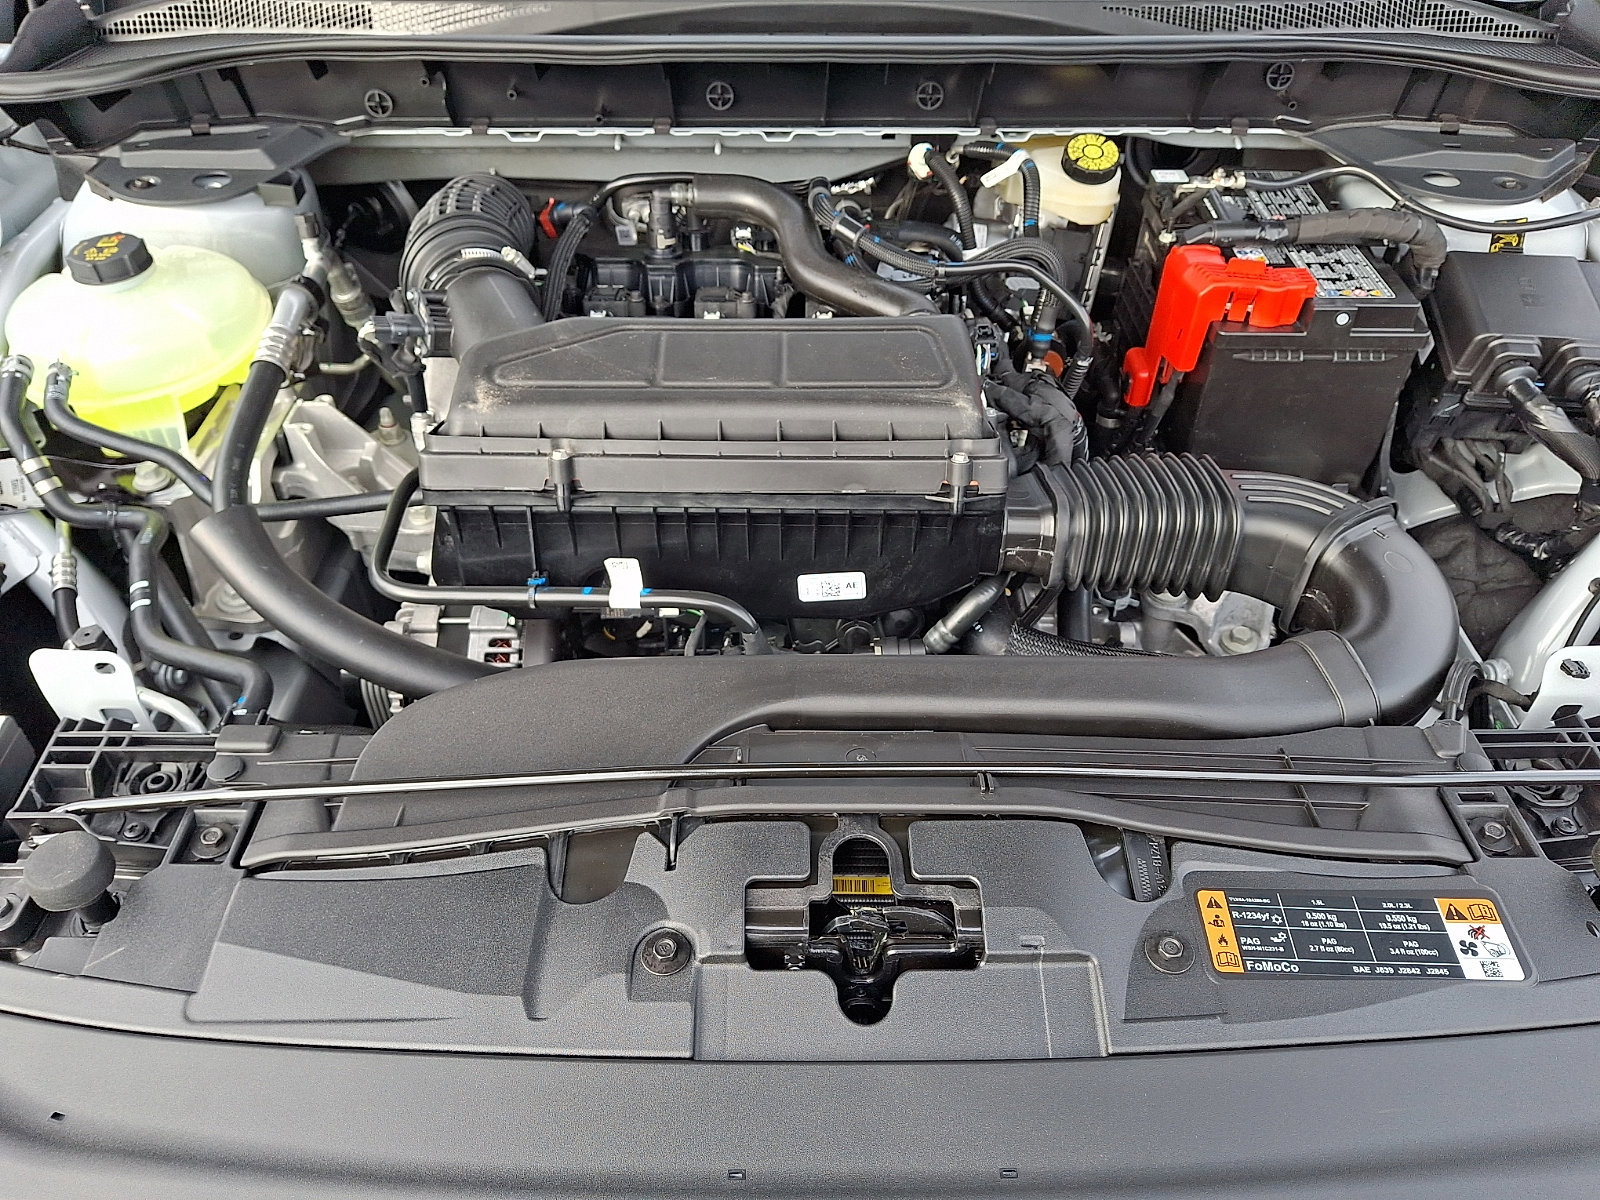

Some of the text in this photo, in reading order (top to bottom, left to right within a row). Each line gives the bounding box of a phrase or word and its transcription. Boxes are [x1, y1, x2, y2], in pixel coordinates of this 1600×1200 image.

[1232, 911, 1270, 922] R-1234yf
[1305, 911, 1338, 922] 0.500 kg
[1385, 914, 1418, 924] 0.550 kg
[1240, 936, 1261, 945] PAG
[1321, 937, 1338, 945] PAG
[1402, 940, 1419, 948] PAG
[1415, 949, 1439, 958] (100cc)
[1246, 961, 1300, 973] FoMoCo
[1352, 965, 1371, 974] SAE
